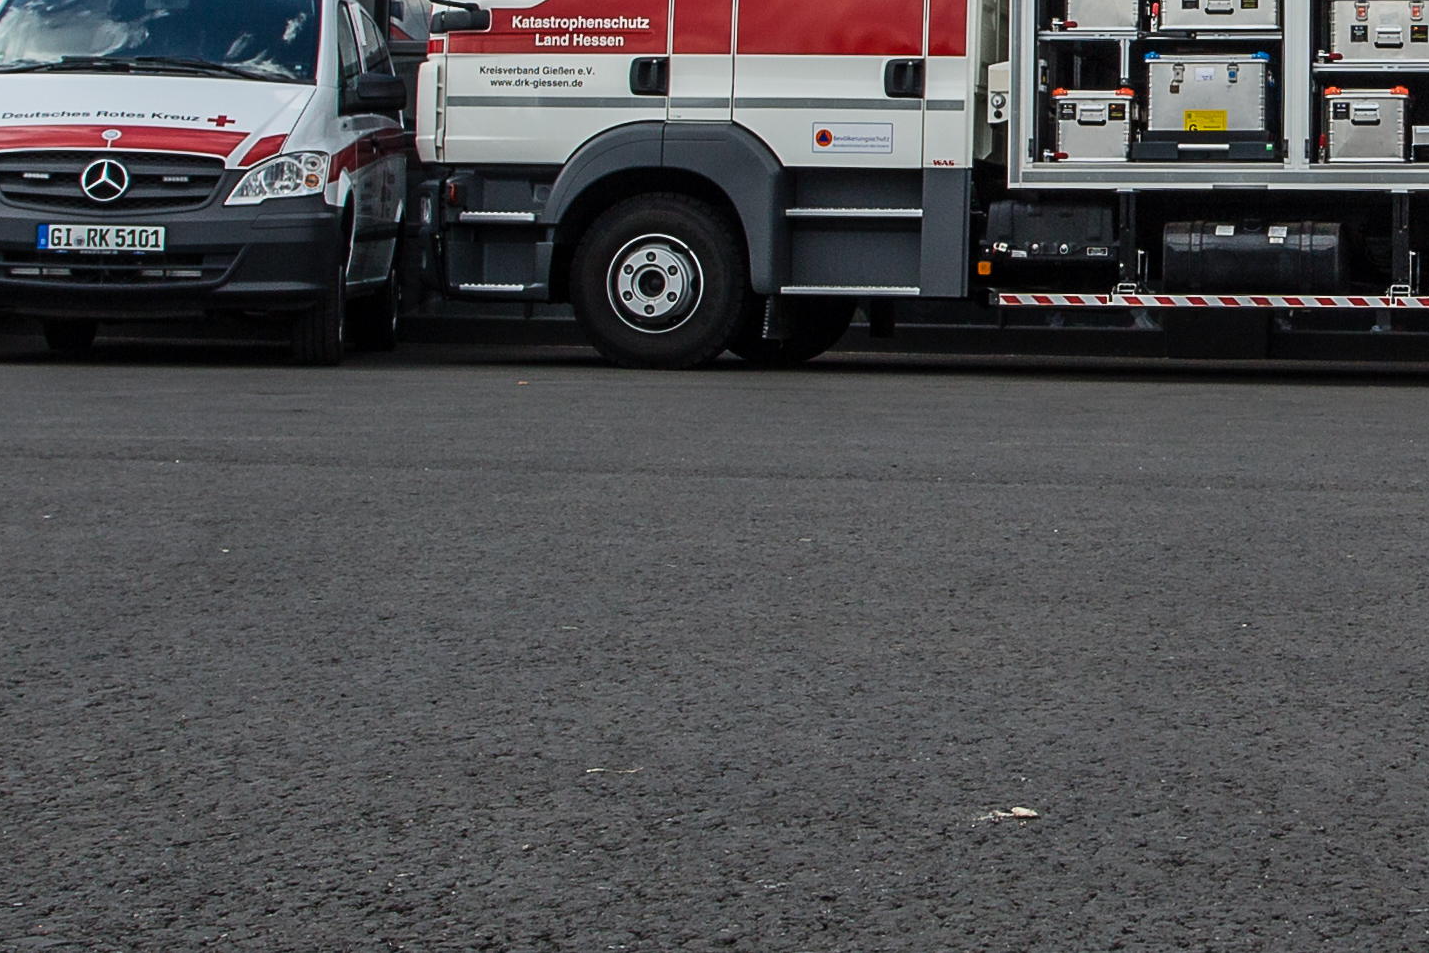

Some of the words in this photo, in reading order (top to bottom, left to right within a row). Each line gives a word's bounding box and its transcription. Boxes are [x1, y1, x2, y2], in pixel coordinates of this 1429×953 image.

[512, 16, 650, 30] Katastrophenschutz
[535, 34, 569, 46] Land
[573, 34, 624, 46] Hessen
[480, 66, 540, 75] Kreisverband
[543, 66, 574, 75] Gießen
[578, 67, 595, 75] e.V.
[490, 79, 583, 88] www.drk-giessen.de
[2, 111, 90, 119] Deutsches
[96, 111, 145, 119] Rotes
[151, 112, 200, 122] Kreuz
[51, 228, 73, 247] GI
[86, 228, 110, 247] RK
[115, 229, 160, 248] 5101
